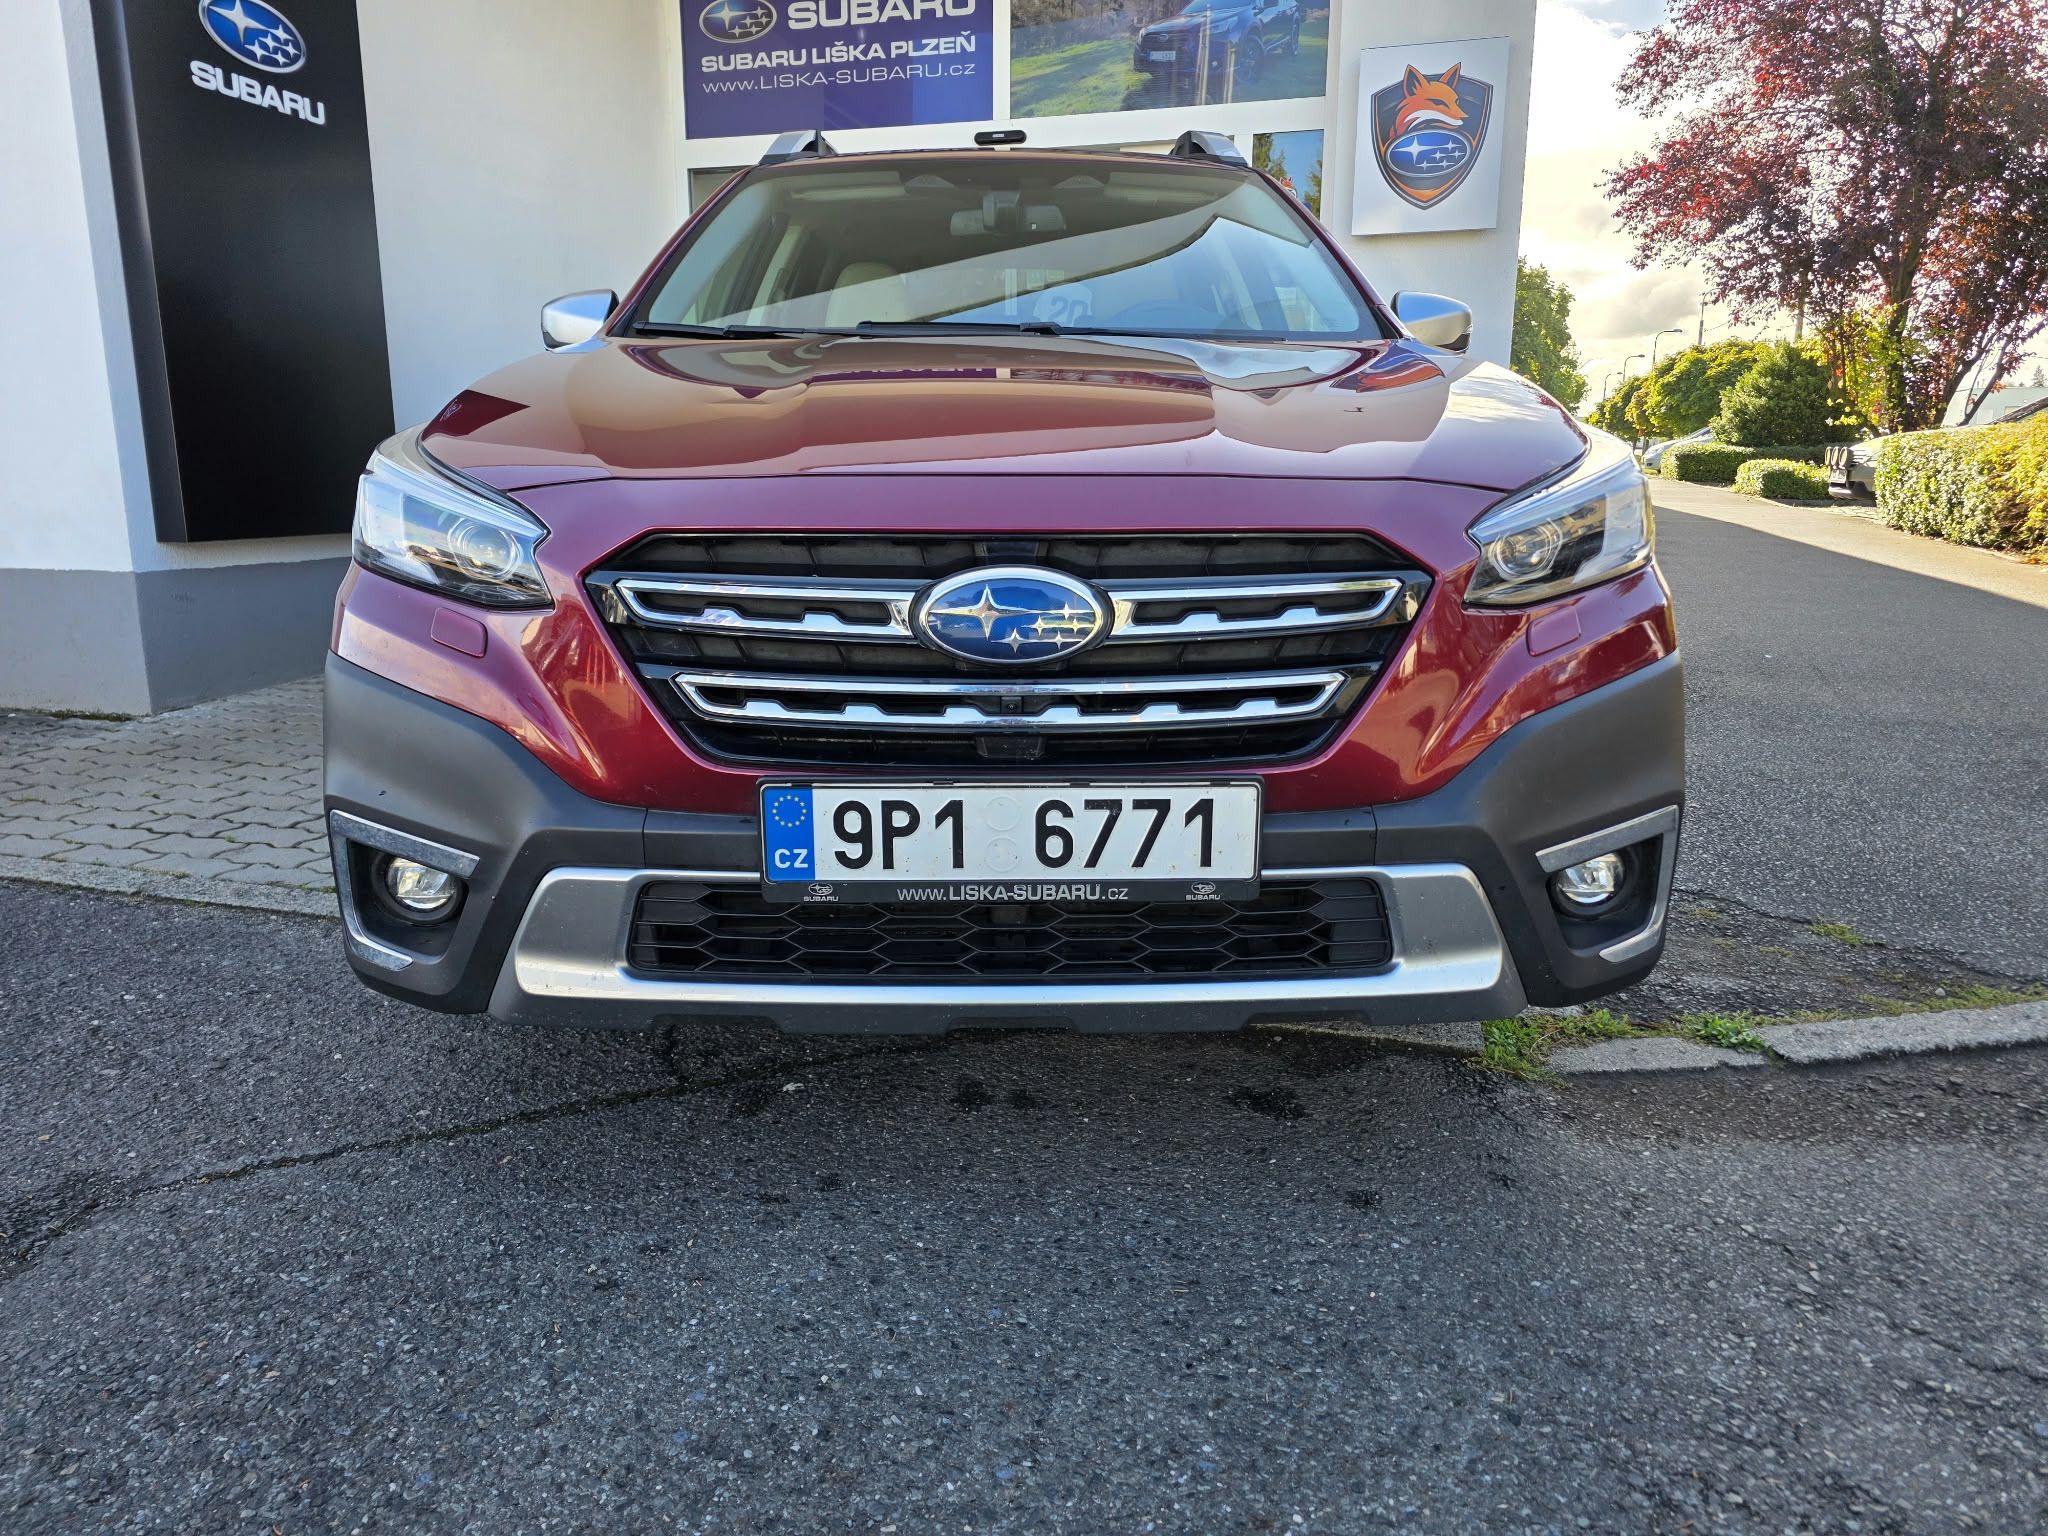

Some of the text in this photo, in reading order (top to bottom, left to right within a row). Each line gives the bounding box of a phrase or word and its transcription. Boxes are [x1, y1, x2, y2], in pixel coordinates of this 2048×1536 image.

[787, 0, 976, 29] SUBARU
[701, 30, 976, 73] SUBARU LIŠKA PLZEŇ
[190, 60, 326, 125] SUBARU
[702, 63, 976, 93] www.LISKA-SUBARU.cz
[833, 798, 1214, 870] 9P1 6771
[774, 848, 809, 869] CZ
[897, 883, 1129, 901] www.LISKA-SUBARU.cz
